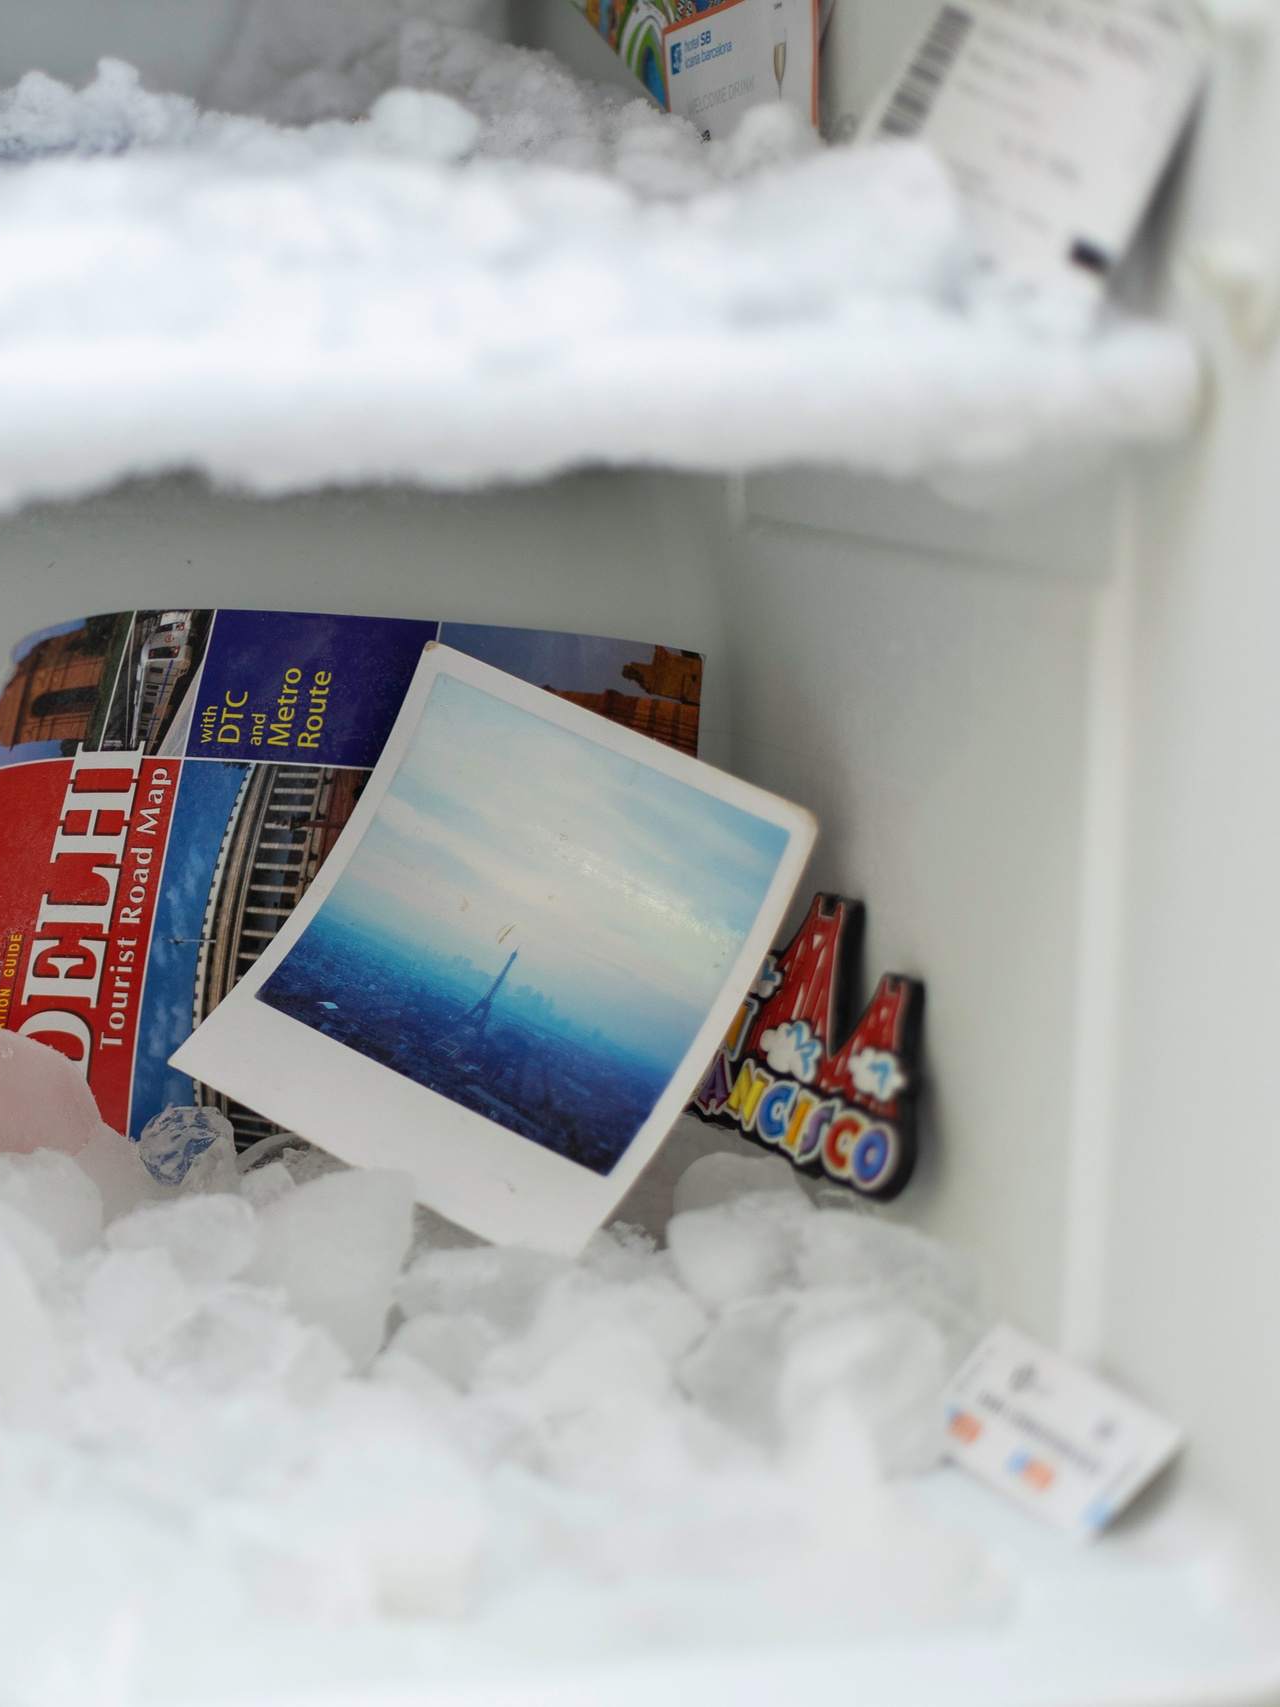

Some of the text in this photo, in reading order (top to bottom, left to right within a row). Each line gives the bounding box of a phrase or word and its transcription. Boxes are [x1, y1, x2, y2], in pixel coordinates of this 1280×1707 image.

[684, 30, 712, 51] hotel SB
[685, 41, 732, 69] icaria barcelona
[728, 75, 756, 99] DRINK
[200, 705, 219, 743] with
[217, 690, 248, 743] DTC
[267, 667, 302, 746] Metro
[297, 670, 332, 748] Route
[250, 713, 266, 746] and
[100, 767, 172, 1050] Tourist Road Map
[3, 934, 23, 978] GUIDE
[694, 1053, 898, 1190] ANCISCO
